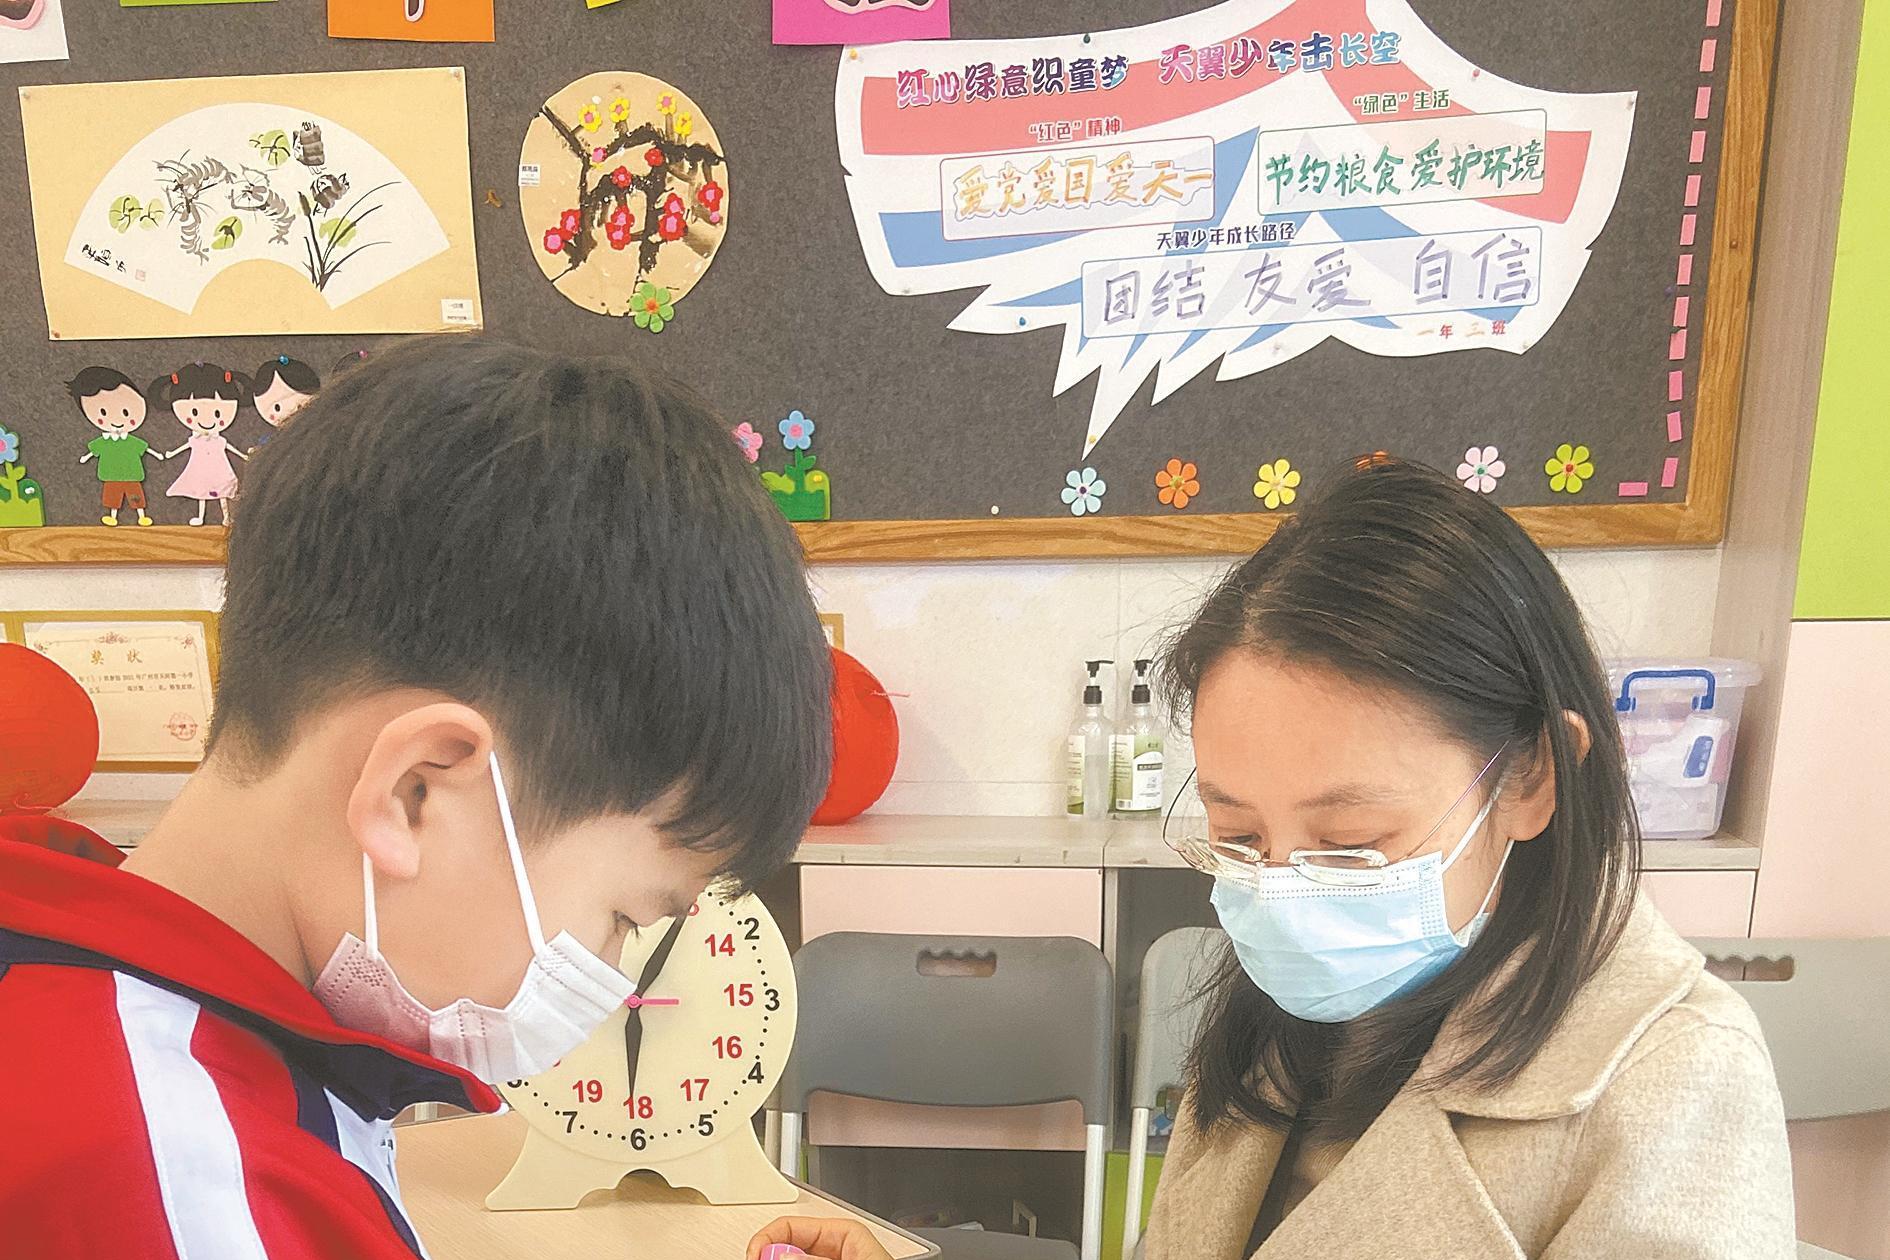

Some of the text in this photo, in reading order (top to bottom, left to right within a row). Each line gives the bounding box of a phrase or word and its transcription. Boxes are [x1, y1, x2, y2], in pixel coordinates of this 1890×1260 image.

[897, 30, 1401, 108] 红心绿意织童梦 天翼少年击长空
[1266, 138, 1545, 206] 节约粮食爱护环境
[1156, 222, 1296, 250] 天翼少年成长路径
[1104, 232, 1532, 326] 团结 友爱 自信
[744, 917, 760, 940] 2
[704, 934, 736, 957] 14
[723, 984, 754, 1007] 15
[764, 989, 780, 1011] 3
[712, 1036, 743, 1059] 16
[747, 1062, 764, 1084] 4
[572, 1079, 603, 1103] 19
[680, 1078, 710, 1101] 17
[623, 1096, 654, 1120] 18
[562, 1111, 578, 1133] 7
[698, 1114, 714, 1136] 5
[630, 1129, 646, 1151] 6
